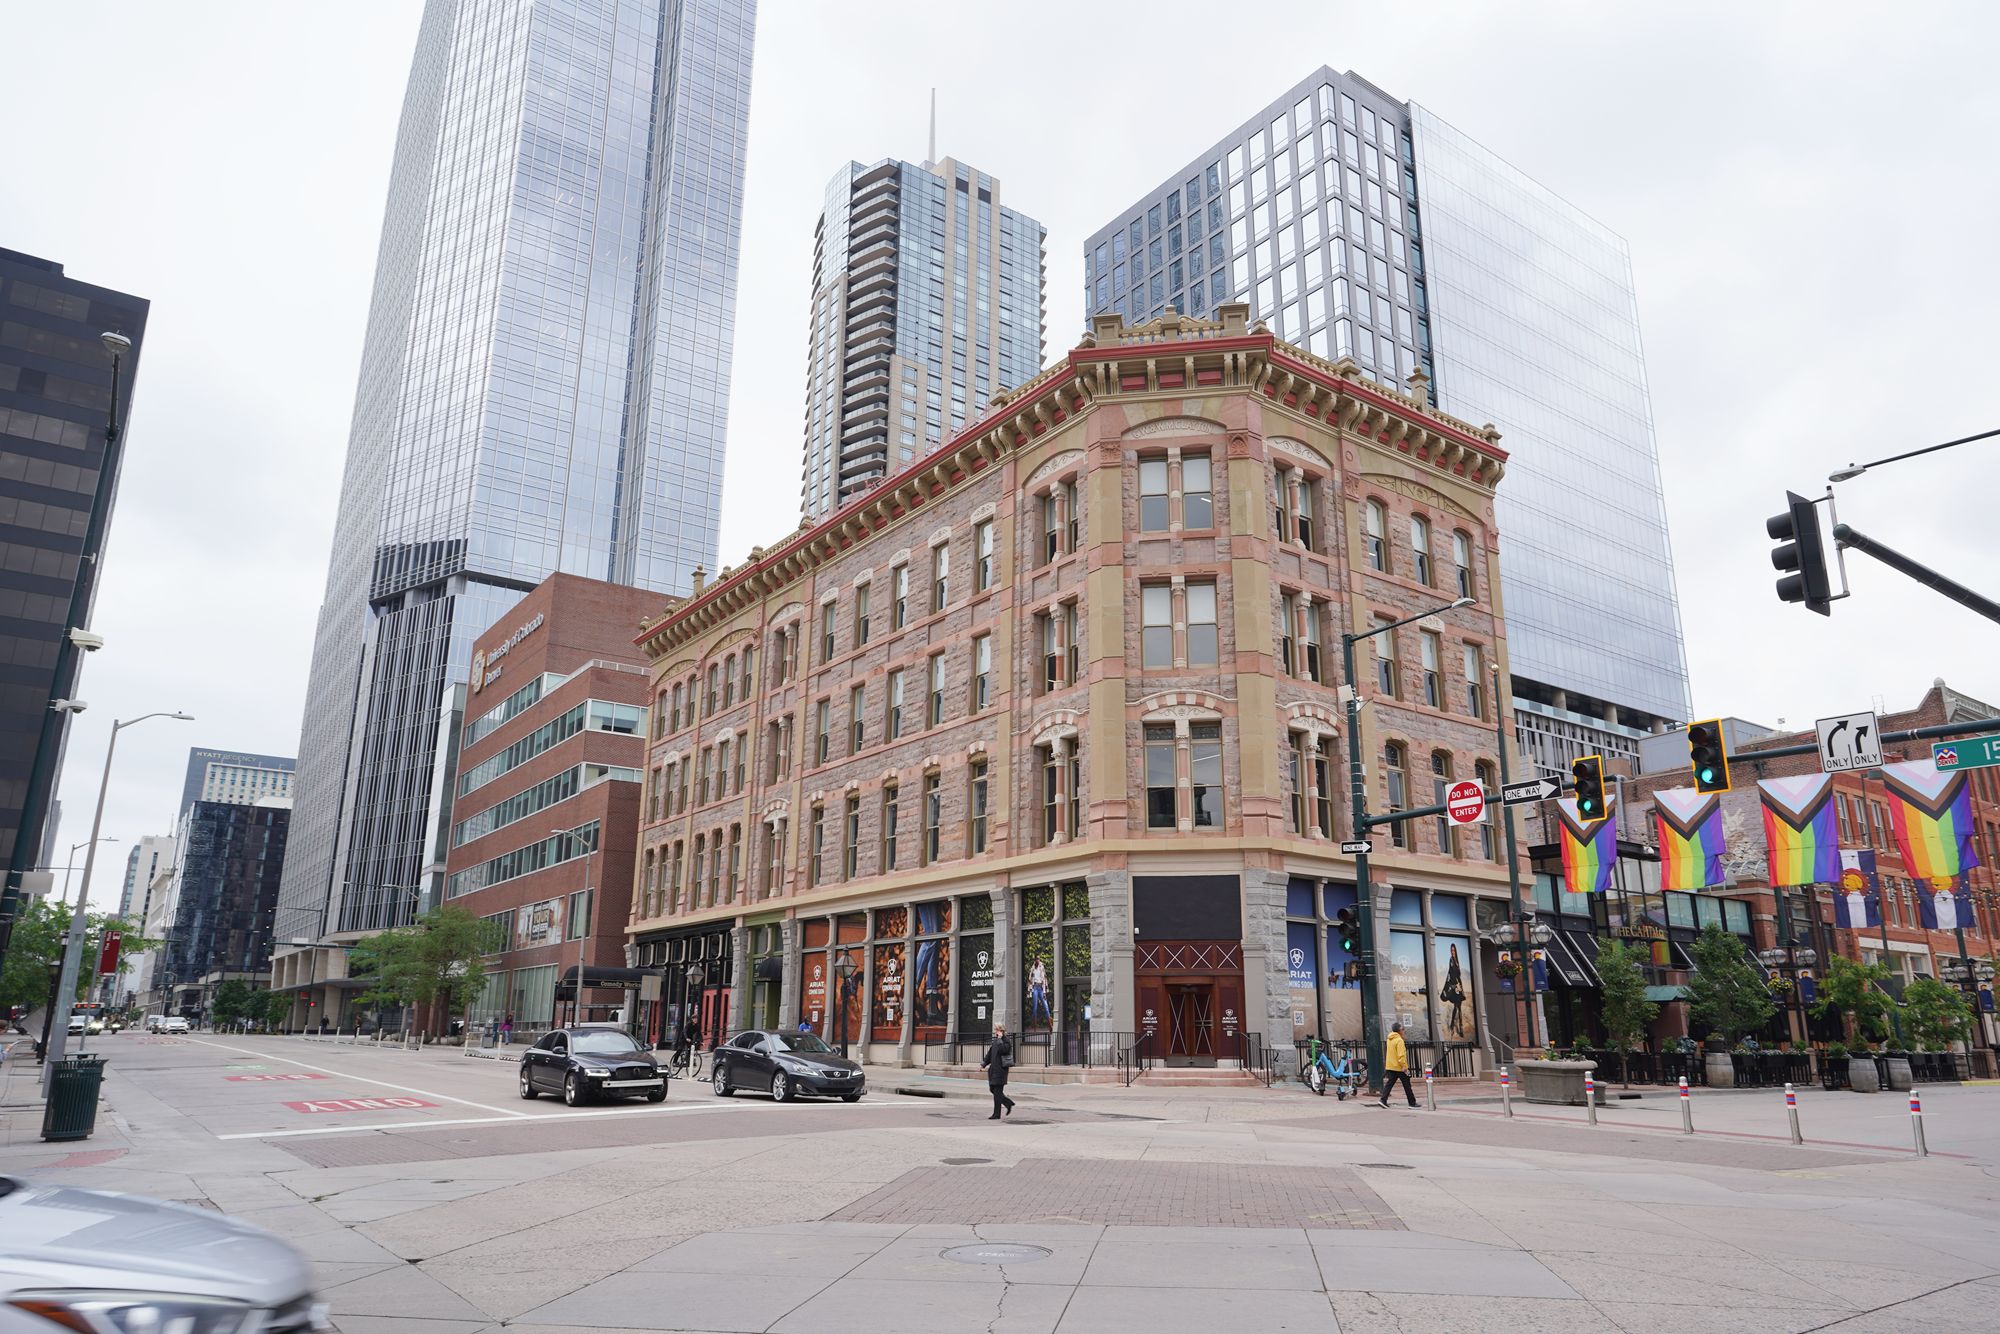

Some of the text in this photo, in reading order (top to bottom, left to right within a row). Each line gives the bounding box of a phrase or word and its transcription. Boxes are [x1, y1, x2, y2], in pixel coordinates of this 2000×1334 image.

[487, 639, 511, 667] University
[518, 612, 544, 642] Colorado
[485, 664, 503, 687] Denver
[196, 751, 257, 762] HYATT REGENCY
[1854, 753, 1878, 765] ONLY
[1826, 756, 1850, 769] ONLY
[1937, 758, 1959, 767] DENVER
[1451, 787, 1478, 799] DO NOT
[1506, 786, 1541, 799] ONE WAY
[1455, 807, 1477, 817] ENTER
[1288, 970, 1312, 979] RIAT
[1393, 975, 1417, 983] ARIAT
[600, 981, 623, 989] Comedy
[971, 979, 985, 987] COMING
[302, 1098, 423, 1111] ONLY
